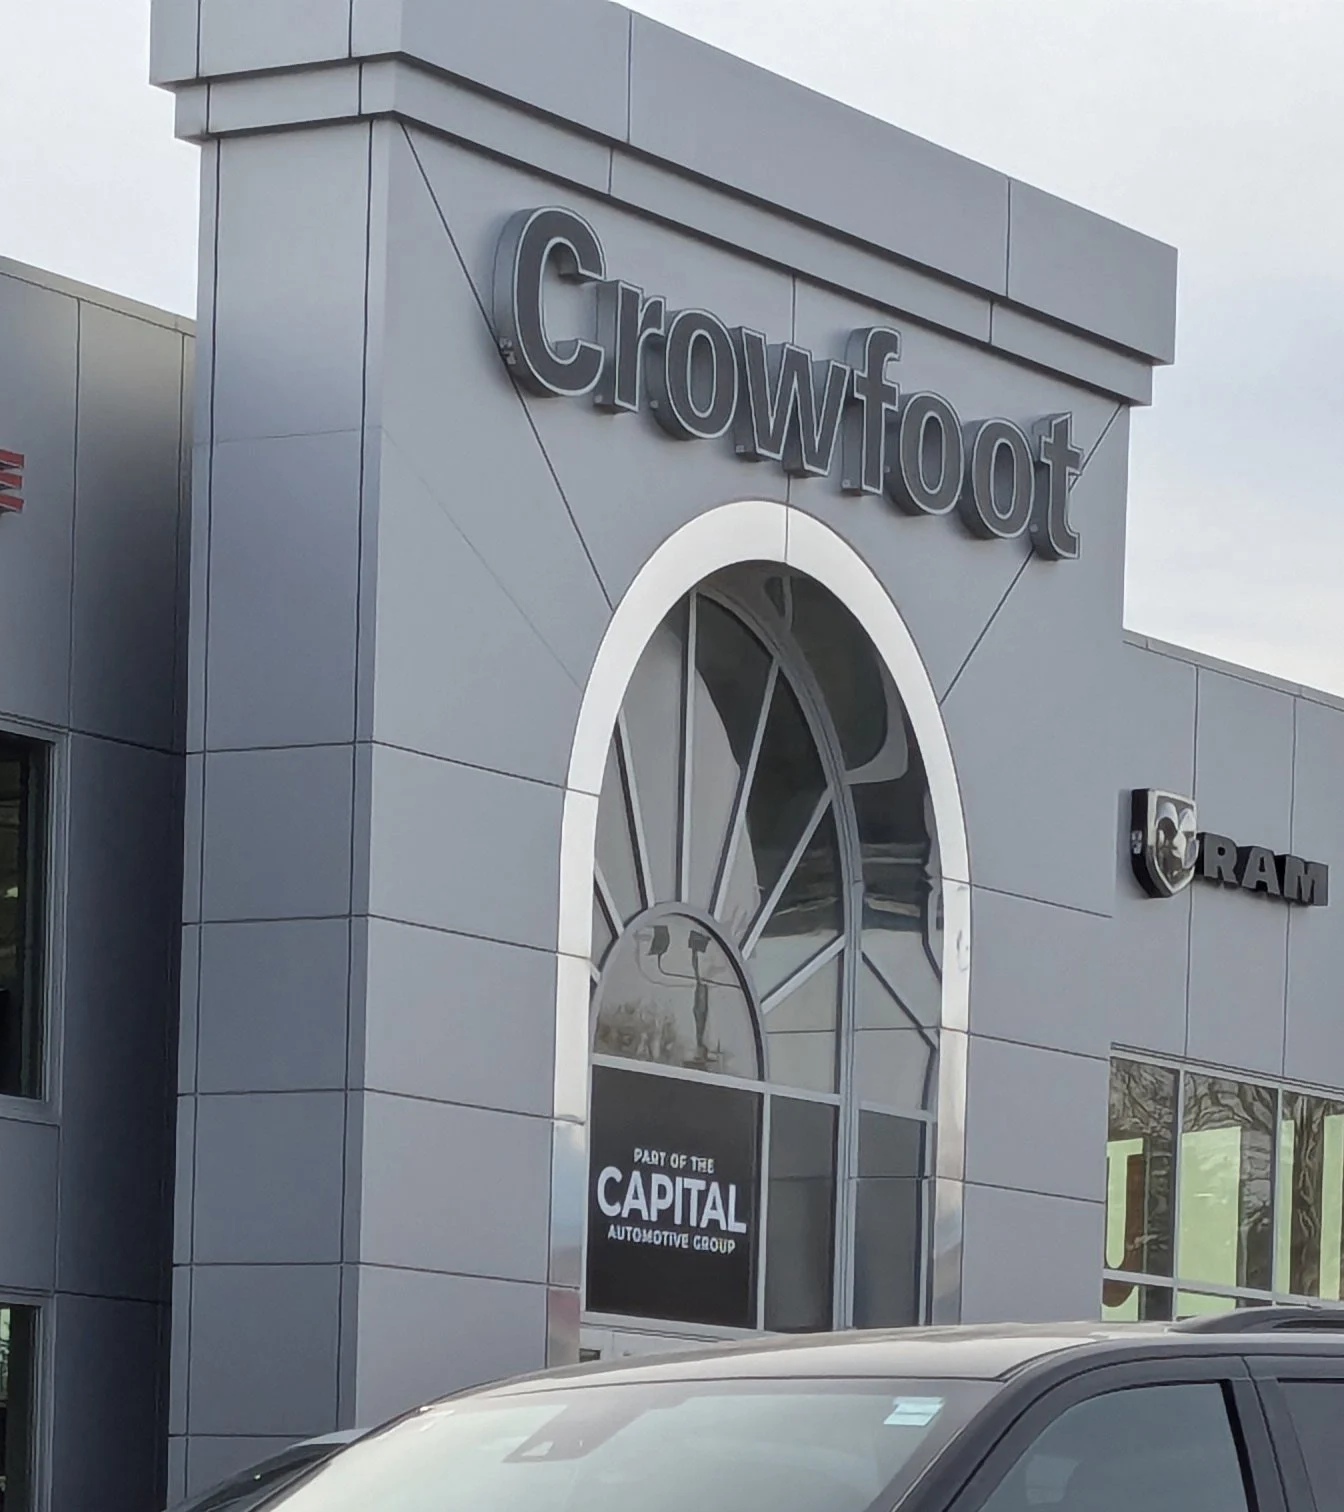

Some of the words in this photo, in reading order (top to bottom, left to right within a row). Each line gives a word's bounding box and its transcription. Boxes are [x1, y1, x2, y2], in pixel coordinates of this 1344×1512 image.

[504, 205, 1084, 560] Crowfoot
[1202, 832, 1329, 907] RAM
[633, 1147, 666, 1167] PART
[670, 1153, 687, 1169] OF
[690, 1156, 715, 1174] THE
[597, 1166, 747, 1233] CAPITAL
[607, 1224, 689, 1249] AUTOMOTIVE
[693, 1235, 736, 1254] GROUP
